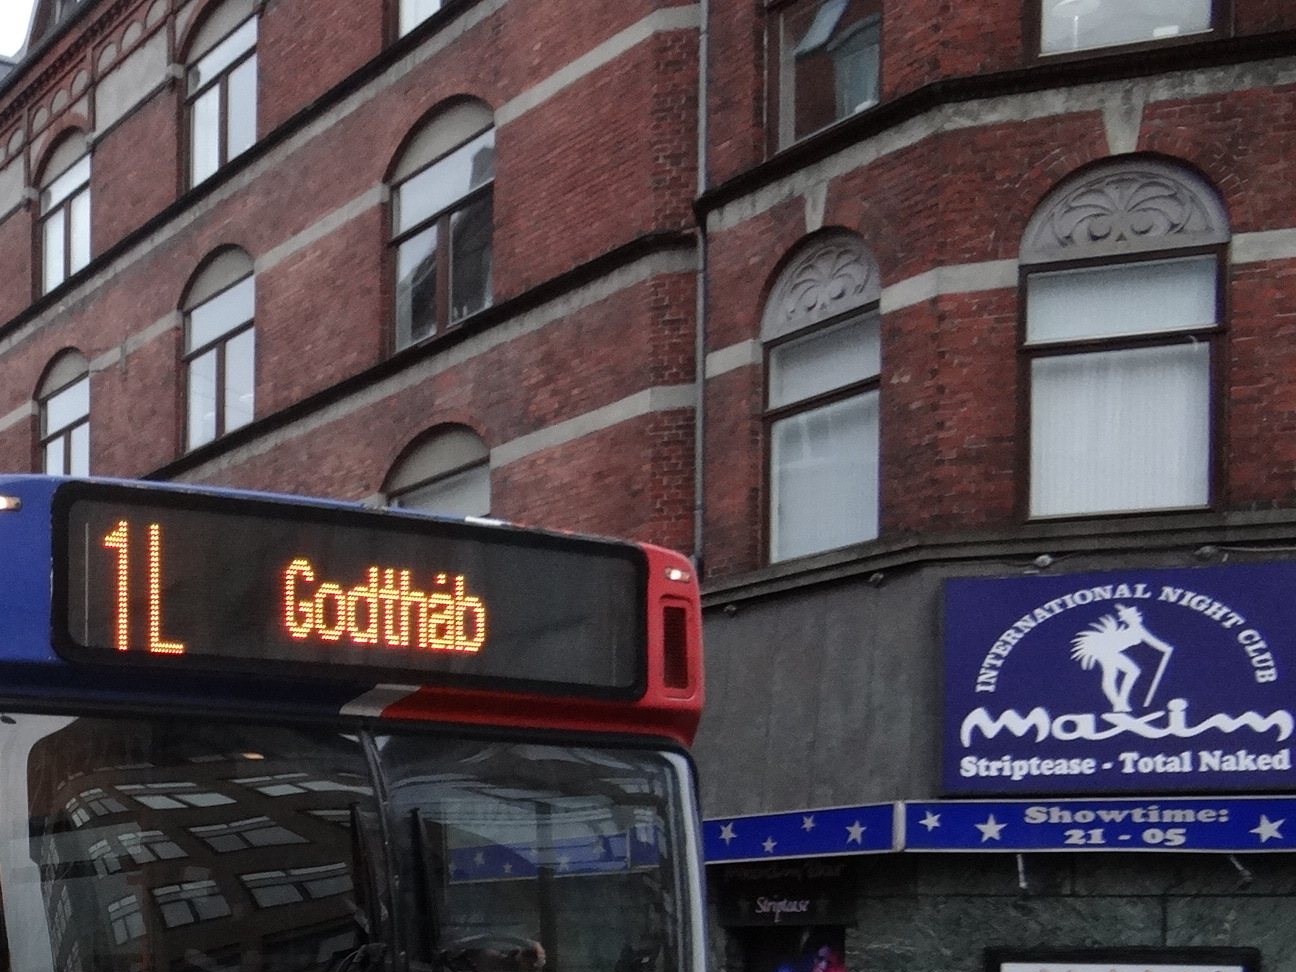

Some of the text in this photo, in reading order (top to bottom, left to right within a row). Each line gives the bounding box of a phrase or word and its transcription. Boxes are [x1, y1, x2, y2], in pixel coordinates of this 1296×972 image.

[103, 520, 184, 654] 1L
[975, 583, 1278, 692] INTERNATIONAL NIGHT CLUB
[960, 753, 1096, 781] Striptease
[1119, 750, 1193, 775] Total
[1198, 749, 1292, 772] Naked
[1024, 805, 1230, 824] Showtime:
[1064, 828, 1106, 845] 21
[1142, 828, 1187, 846] 05
